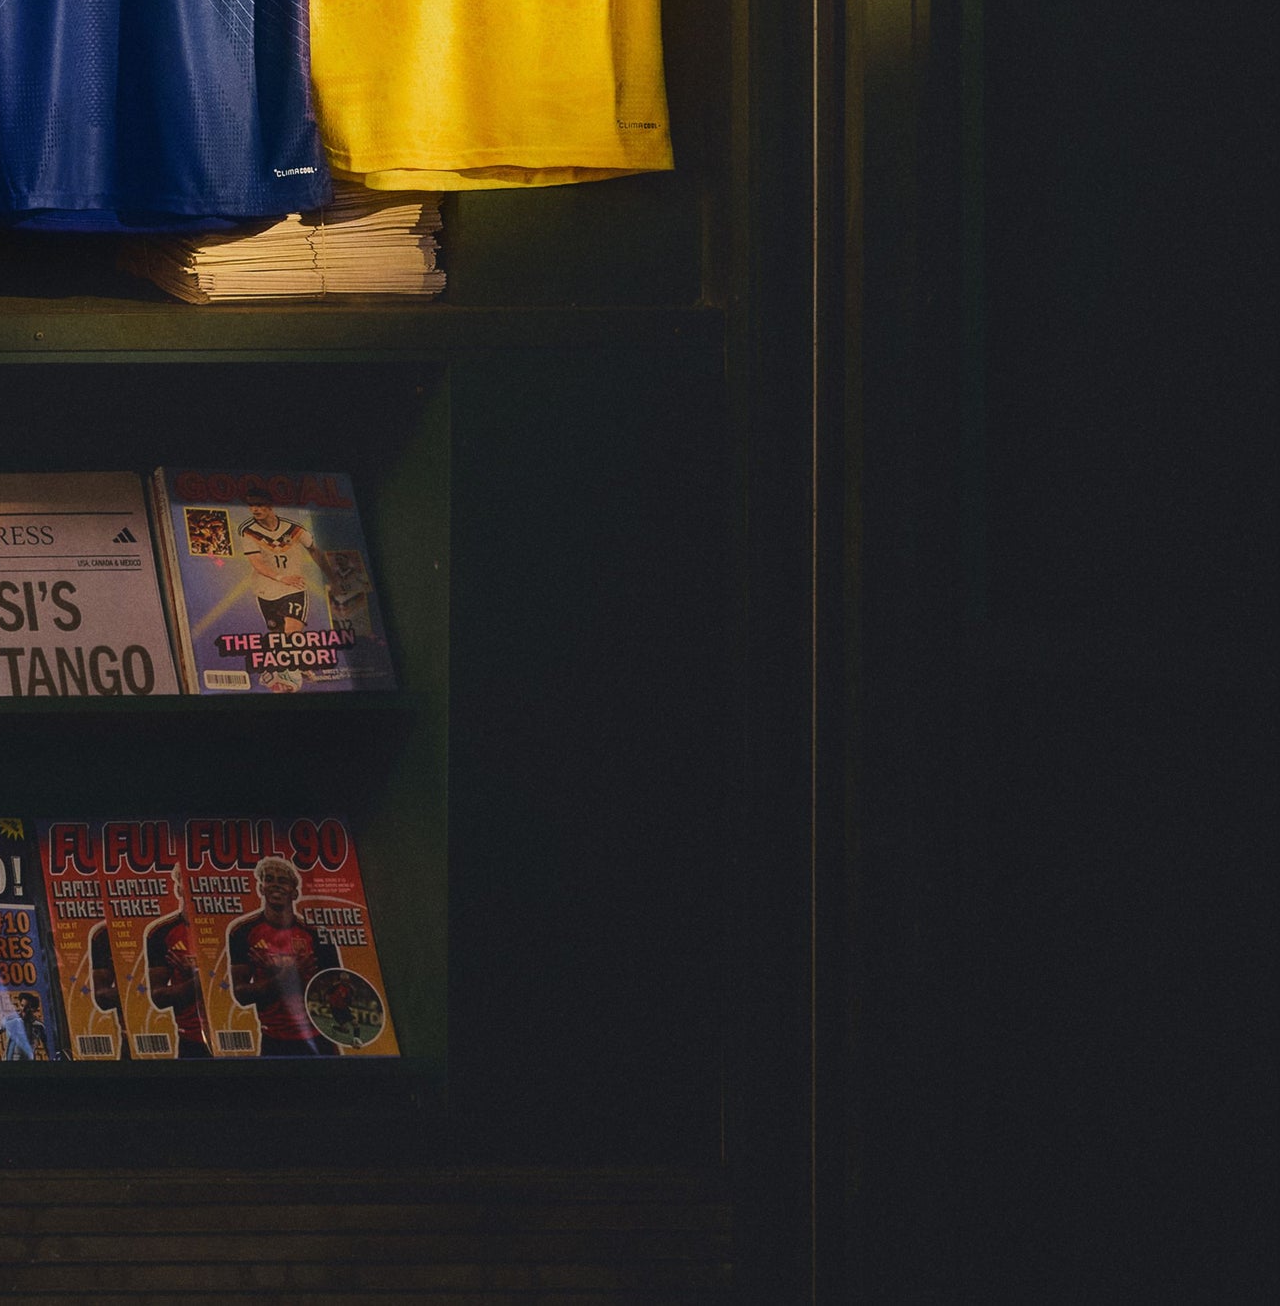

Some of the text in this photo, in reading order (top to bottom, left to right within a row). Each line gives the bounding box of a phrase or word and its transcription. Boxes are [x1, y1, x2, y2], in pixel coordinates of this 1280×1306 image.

[274, 555, 287, 569] 17
[221, 630, 355, 651] THE FLORIAN
[251, 649, 337, 668] FACTOR!
[49, 823, 98, 876] FU
[102, 820, 176, 874] FUL
[184, 817, 348, 872] FULL 90
[52, 880, 100, 898] LAMIN
[107, 878, 168, 896] LAMINE
[190, 876, 251, 894] LAMINE
[55, 901, 105, 919] TAKES
[109, 899, 161, 917] TAKES
[192, 896, 243, 914] TAKES
[303, 907, 365, 925] CENTRE
[317, 928, 368, 945] STAGE
